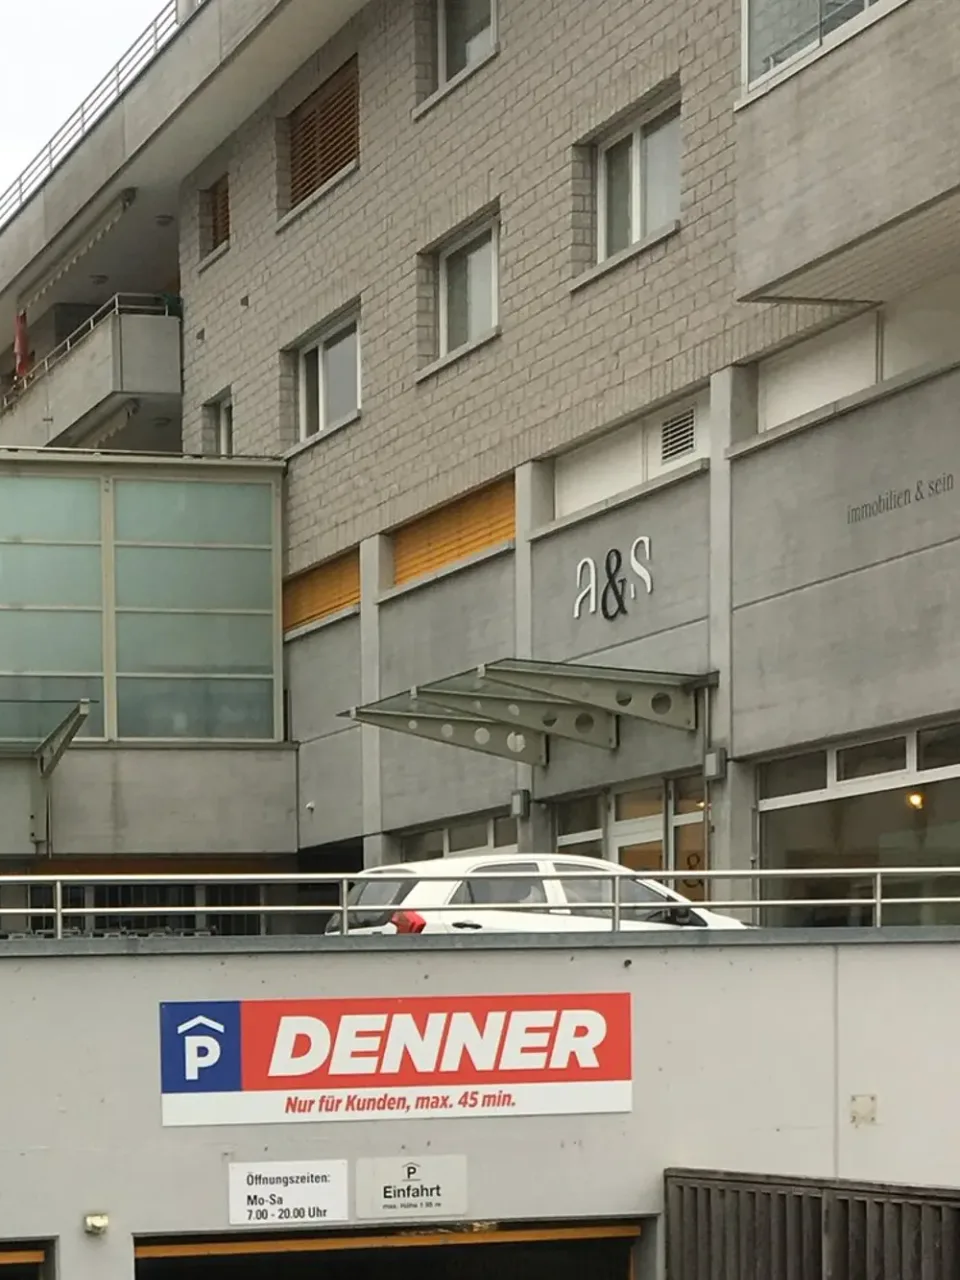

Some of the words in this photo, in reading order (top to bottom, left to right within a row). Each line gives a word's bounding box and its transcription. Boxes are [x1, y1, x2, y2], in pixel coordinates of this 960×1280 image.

[847, 490, 911, 524] immobilien
[915, 480, 925, 501] &
[928, 472, 954, 498] sein
[267, 1008, 608, 1079] DENNER
[185, 1035, 221, 1080] P
[285, 1096, 315, 1113] Nur
[318, 1095, 342, 1113] für
[345, 1093, 411, 1113] Kunden,
[415, 1096, 454, 1110] max.
[458, 1091, 479, 1108] 45
[481, 1090, 517, 1107] min.
[246, 1171, 331, 1187] Öffnungszeiten:
[407, 1166, 417, 1179] P
[246, 1193, 284, 1206] Mo-Sa
[383, 1184, 442, 1199] Einfahrt
[247, 1209, 269, 1220] 7.00
[278, 1207, 305, 1219] 20.00
[308, 1206, 327, 1218] Uhr
